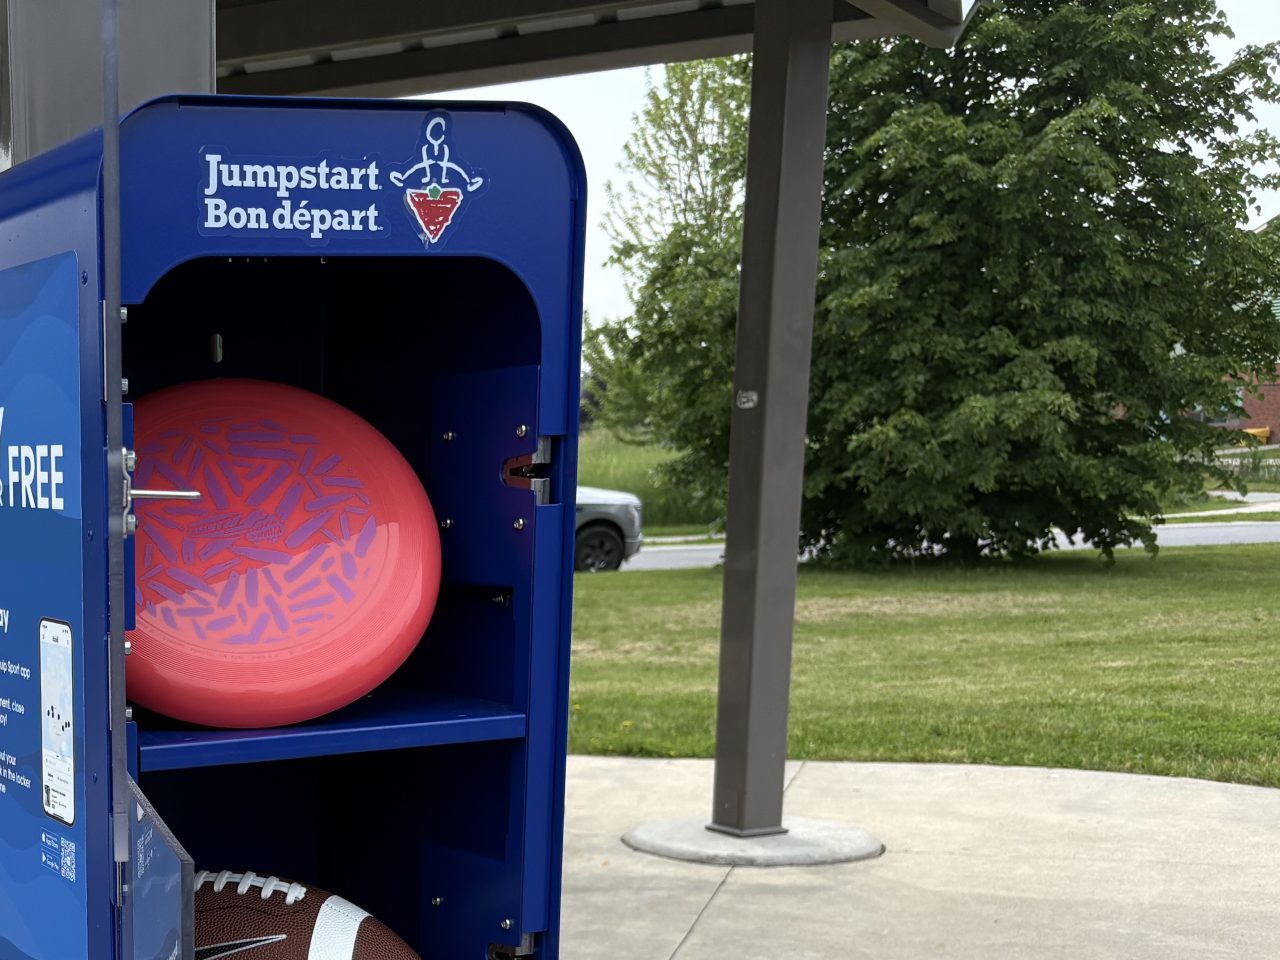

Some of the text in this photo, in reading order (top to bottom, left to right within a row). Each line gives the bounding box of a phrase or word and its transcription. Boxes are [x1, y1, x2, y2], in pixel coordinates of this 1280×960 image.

[204, 154, 380, 197] Jumpstart
[204, 198, 378, 238] Bon départ
[8, 444, 64, 510] FREE
[7, 660, 20, 675] Sport
[20, 666, 31, 680] app
[11, 700, 25, 714] close
[5, 753, 17, 766] your
[2, 766, 7, 778] in
[7, 768, 16, 782] the
[15, 772, 31, 789] locker
